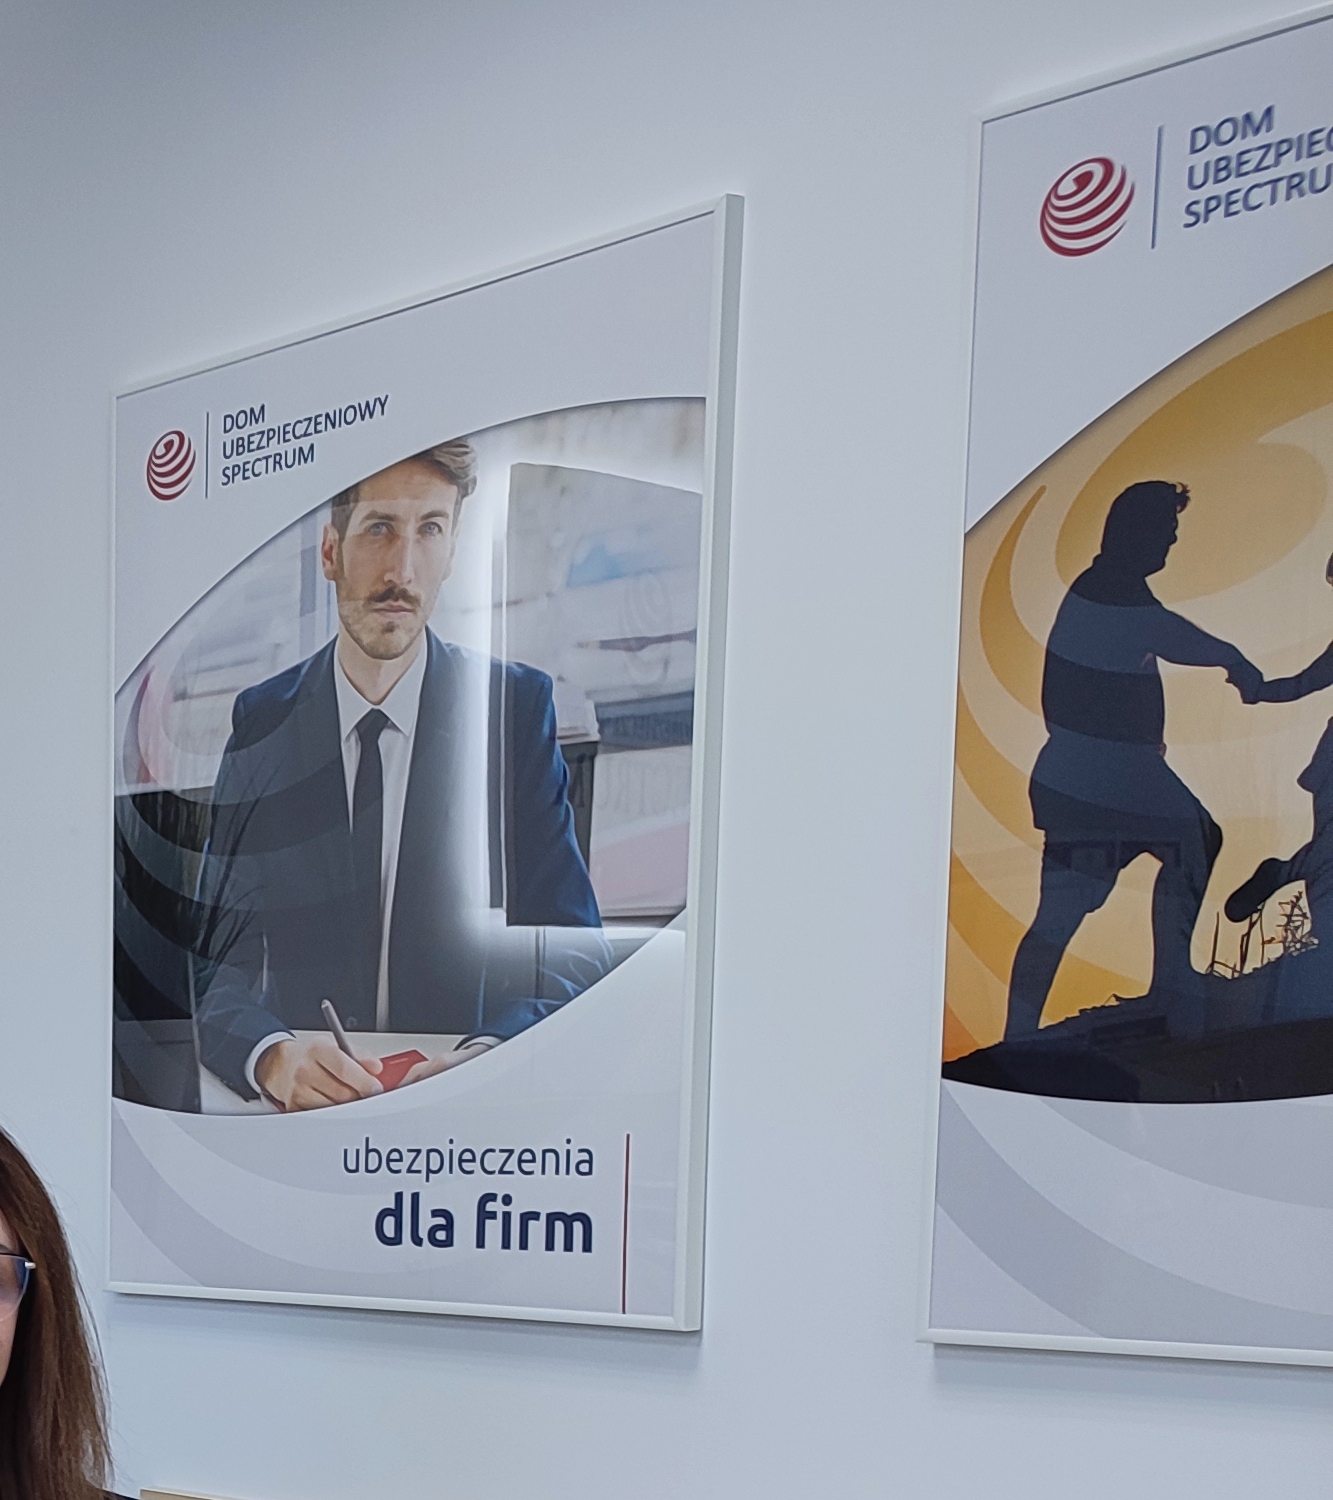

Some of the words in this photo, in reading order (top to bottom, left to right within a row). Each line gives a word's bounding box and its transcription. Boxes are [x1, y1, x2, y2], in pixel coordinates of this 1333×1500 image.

[1189, 104, 1275, 155] DOM
[1183, 162, 1333, 229] SPECTRU
[222, 394, 389, 460] UBEZPIECZENIOWY
[223, 403, 266, 435] DOM
[221, 442, 315, 487] SPECTRUM
[342, 1136, 594, 1183] ubezpieczenia
[374, 1190, 455, 1249] dla
[475, 1192, 593, 1254] firm
